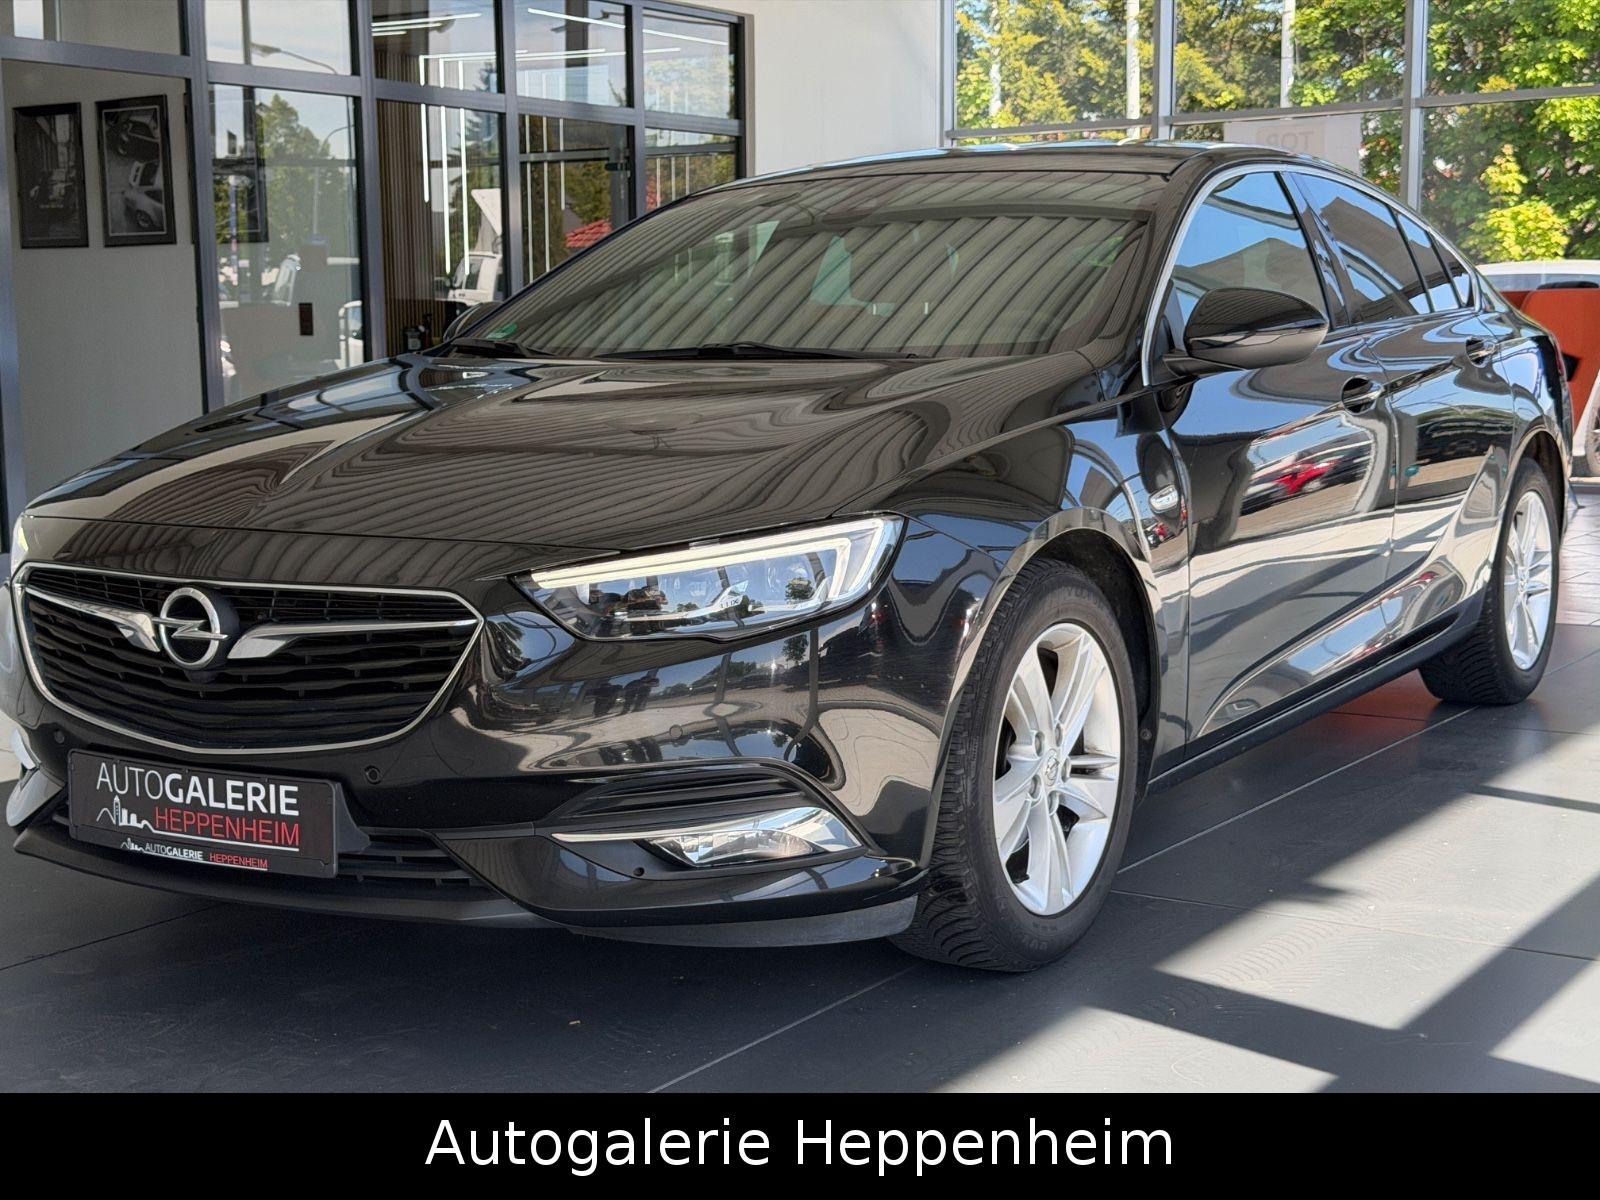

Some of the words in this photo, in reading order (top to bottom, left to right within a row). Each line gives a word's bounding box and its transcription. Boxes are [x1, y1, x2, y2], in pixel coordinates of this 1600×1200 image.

[96, 761, 299, 816] AUTOGALERIE
[154, 806, 299, 847] HEPPENHEIM
[145, 842, 203, 860] AUTOGALERIE
[209, 853, 268, 868] HEPPENHEIM
